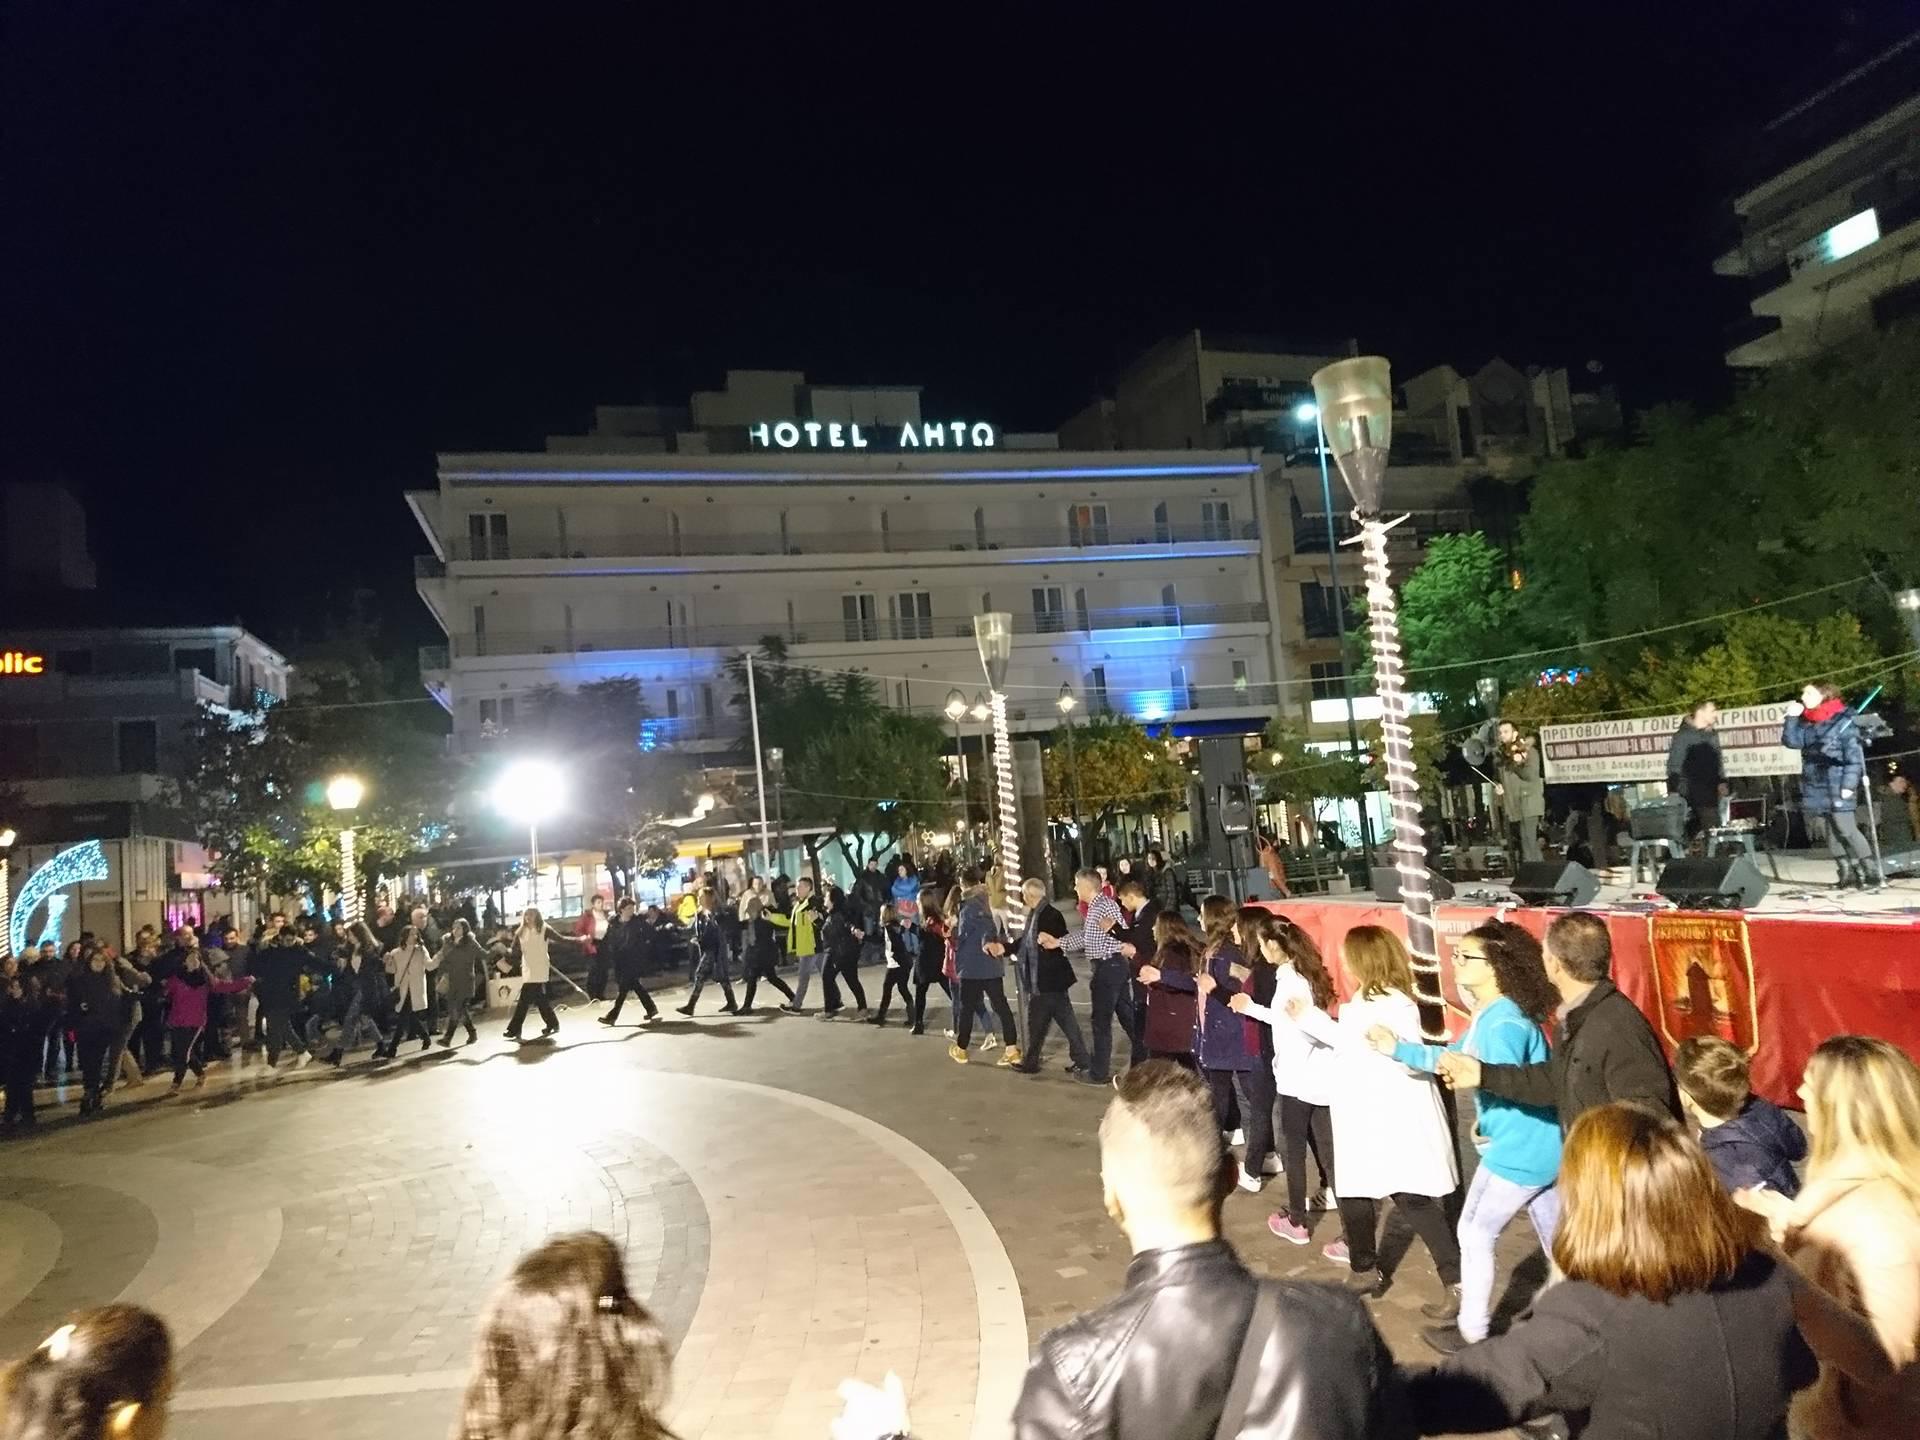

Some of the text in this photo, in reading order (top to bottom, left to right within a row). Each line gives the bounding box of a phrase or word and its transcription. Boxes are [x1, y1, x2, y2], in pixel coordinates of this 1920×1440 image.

[749, 421, 995, 448] HOTEL ΛΗΤΩ
[1543, 723, 1634, 741] ΠΡΩΤΟΒΟΥΛΙΑ
[1641, 718, 1681, 732] ΓΟΝΕ
